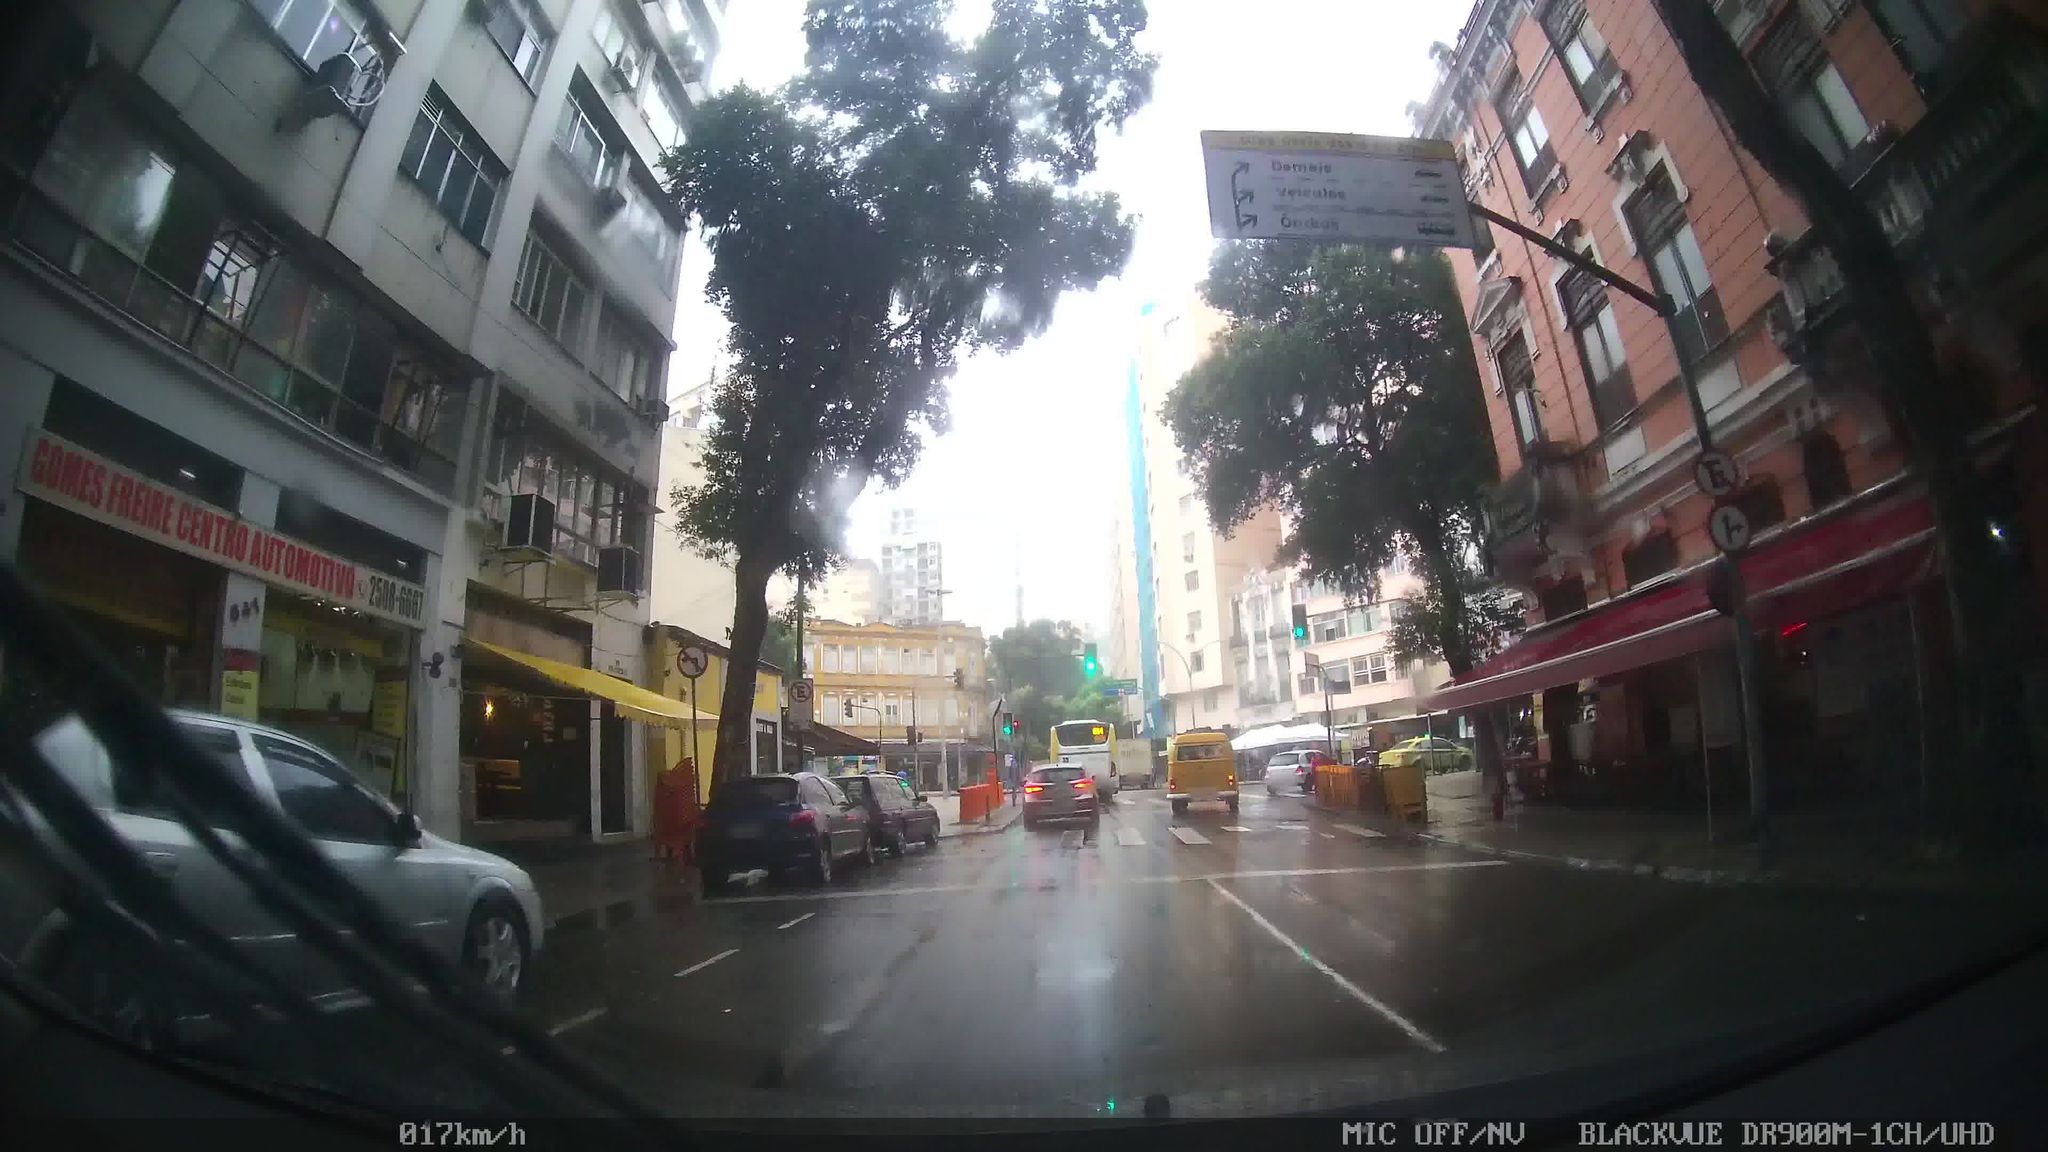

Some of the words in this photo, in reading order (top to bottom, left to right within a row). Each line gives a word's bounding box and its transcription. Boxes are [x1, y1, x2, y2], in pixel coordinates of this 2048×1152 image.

[31, 438, 106, 508] GOMES
[107, 472, 176, 535] FREIRE
[176, 502, 248, 562] CENTRO
[250, 528, 355, 600] AUTOMOTIVO
